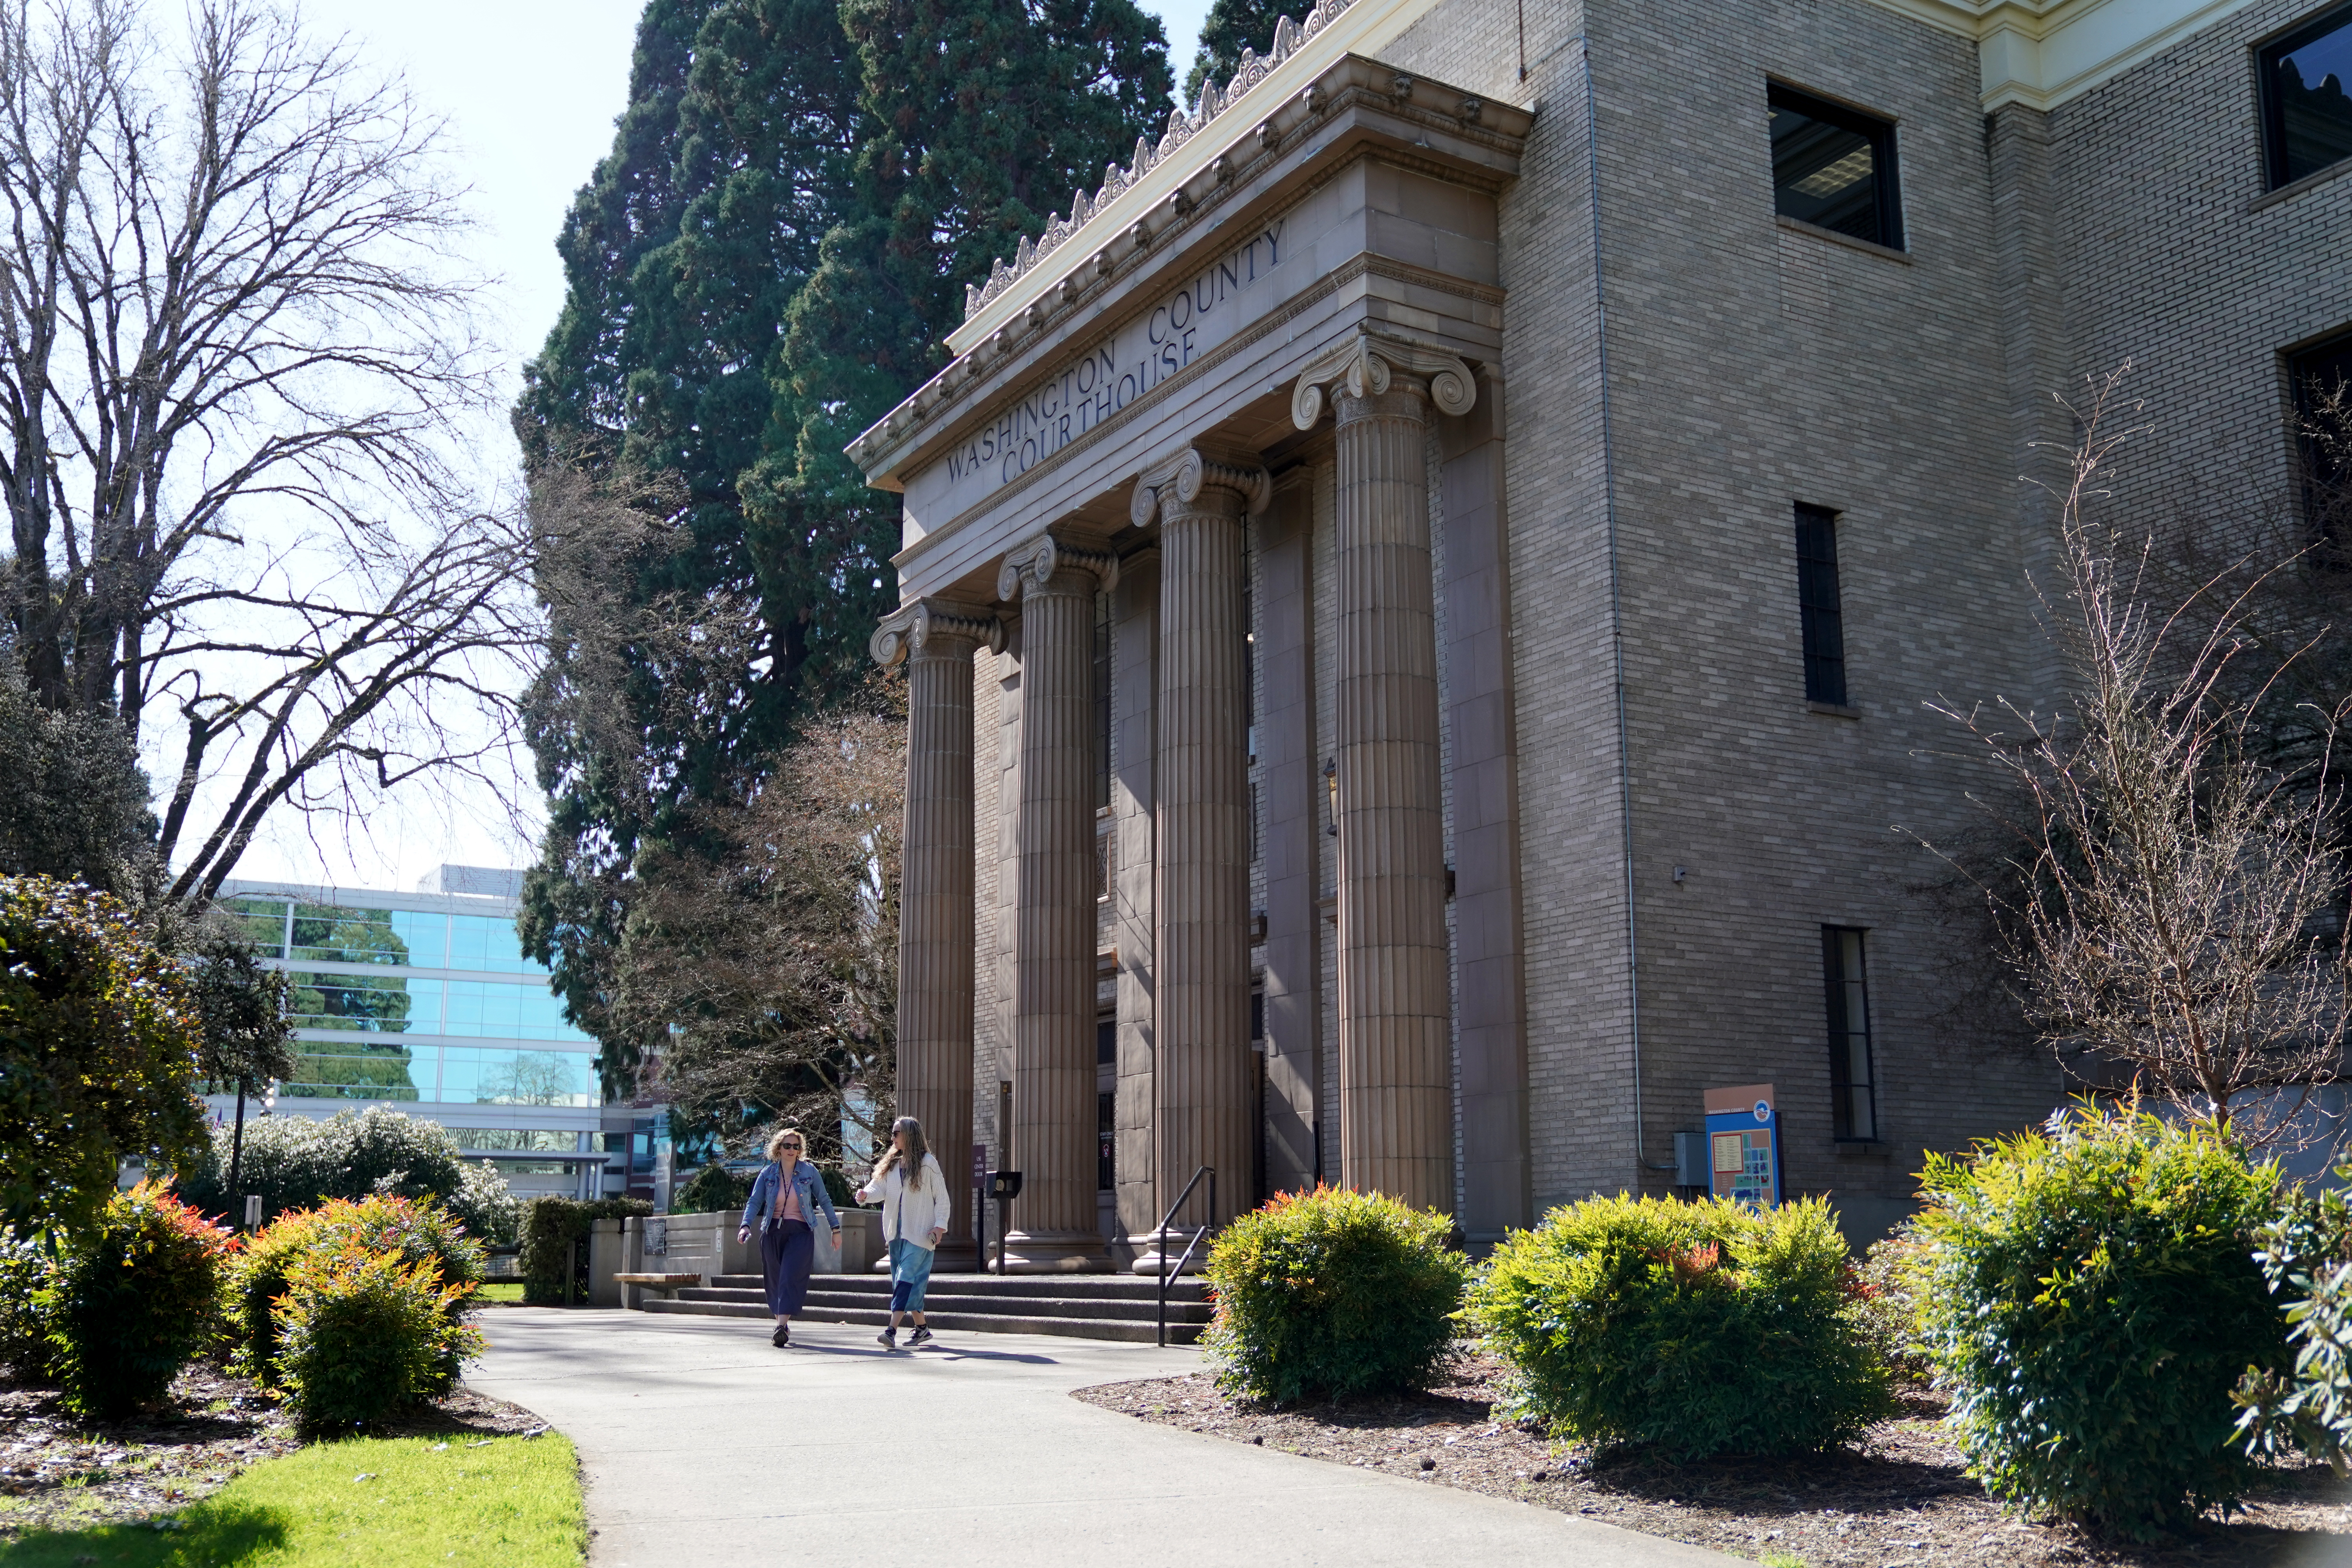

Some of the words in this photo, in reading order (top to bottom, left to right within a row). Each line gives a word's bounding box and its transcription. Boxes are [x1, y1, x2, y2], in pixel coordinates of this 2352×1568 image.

[947, 338, 1116, 485] WASHINGTON
[1149, 218, 1285, 345] COUNTY
[1003, 327, 1200, 484] COURTHOUSE
